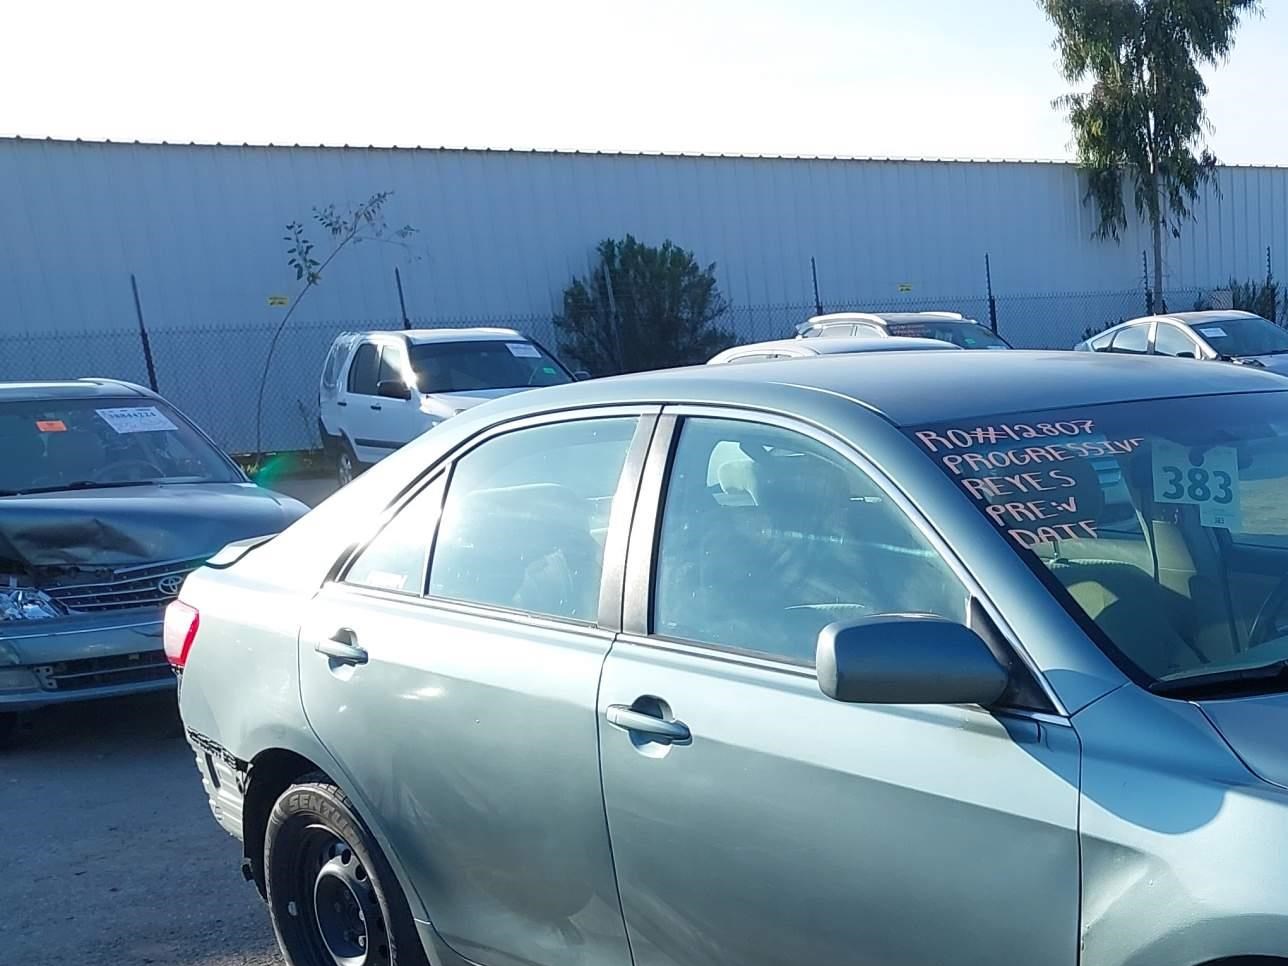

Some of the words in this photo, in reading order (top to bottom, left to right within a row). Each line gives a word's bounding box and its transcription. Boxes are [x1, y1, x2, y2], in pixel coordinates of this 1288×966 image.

[915, 420, 1095, 452] RO#12807
[961, 470, 1076, 500] REYES
[1162, 466, 1232, 505] 383
